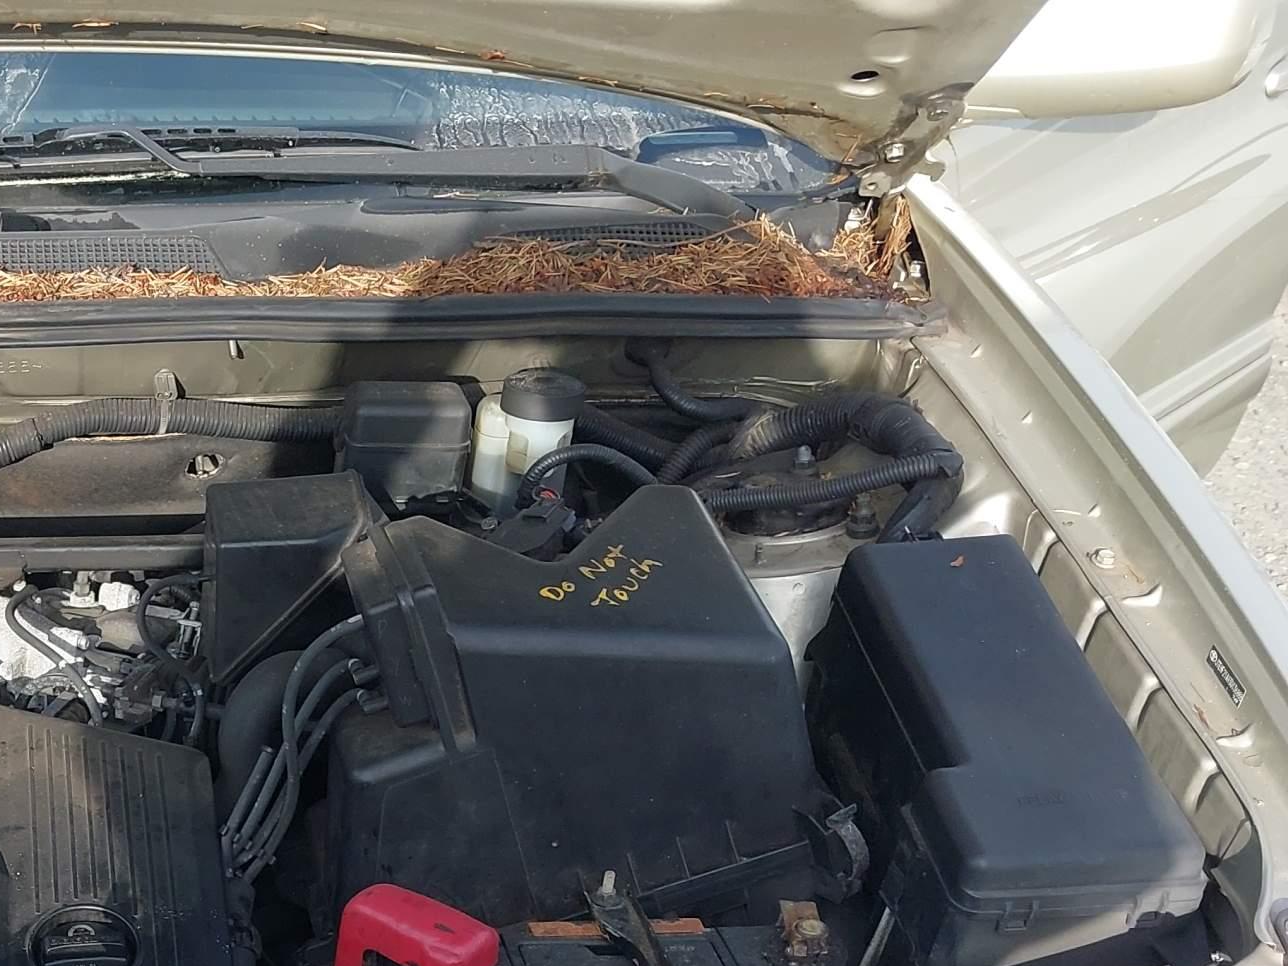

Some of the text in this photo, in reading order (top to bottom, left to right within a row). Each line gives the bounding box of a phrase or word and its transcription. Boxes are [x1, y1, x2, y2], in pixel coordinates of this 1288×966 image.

[539, 544, 627, 601] Do Not
[590, 558, 663, 606] Touch
